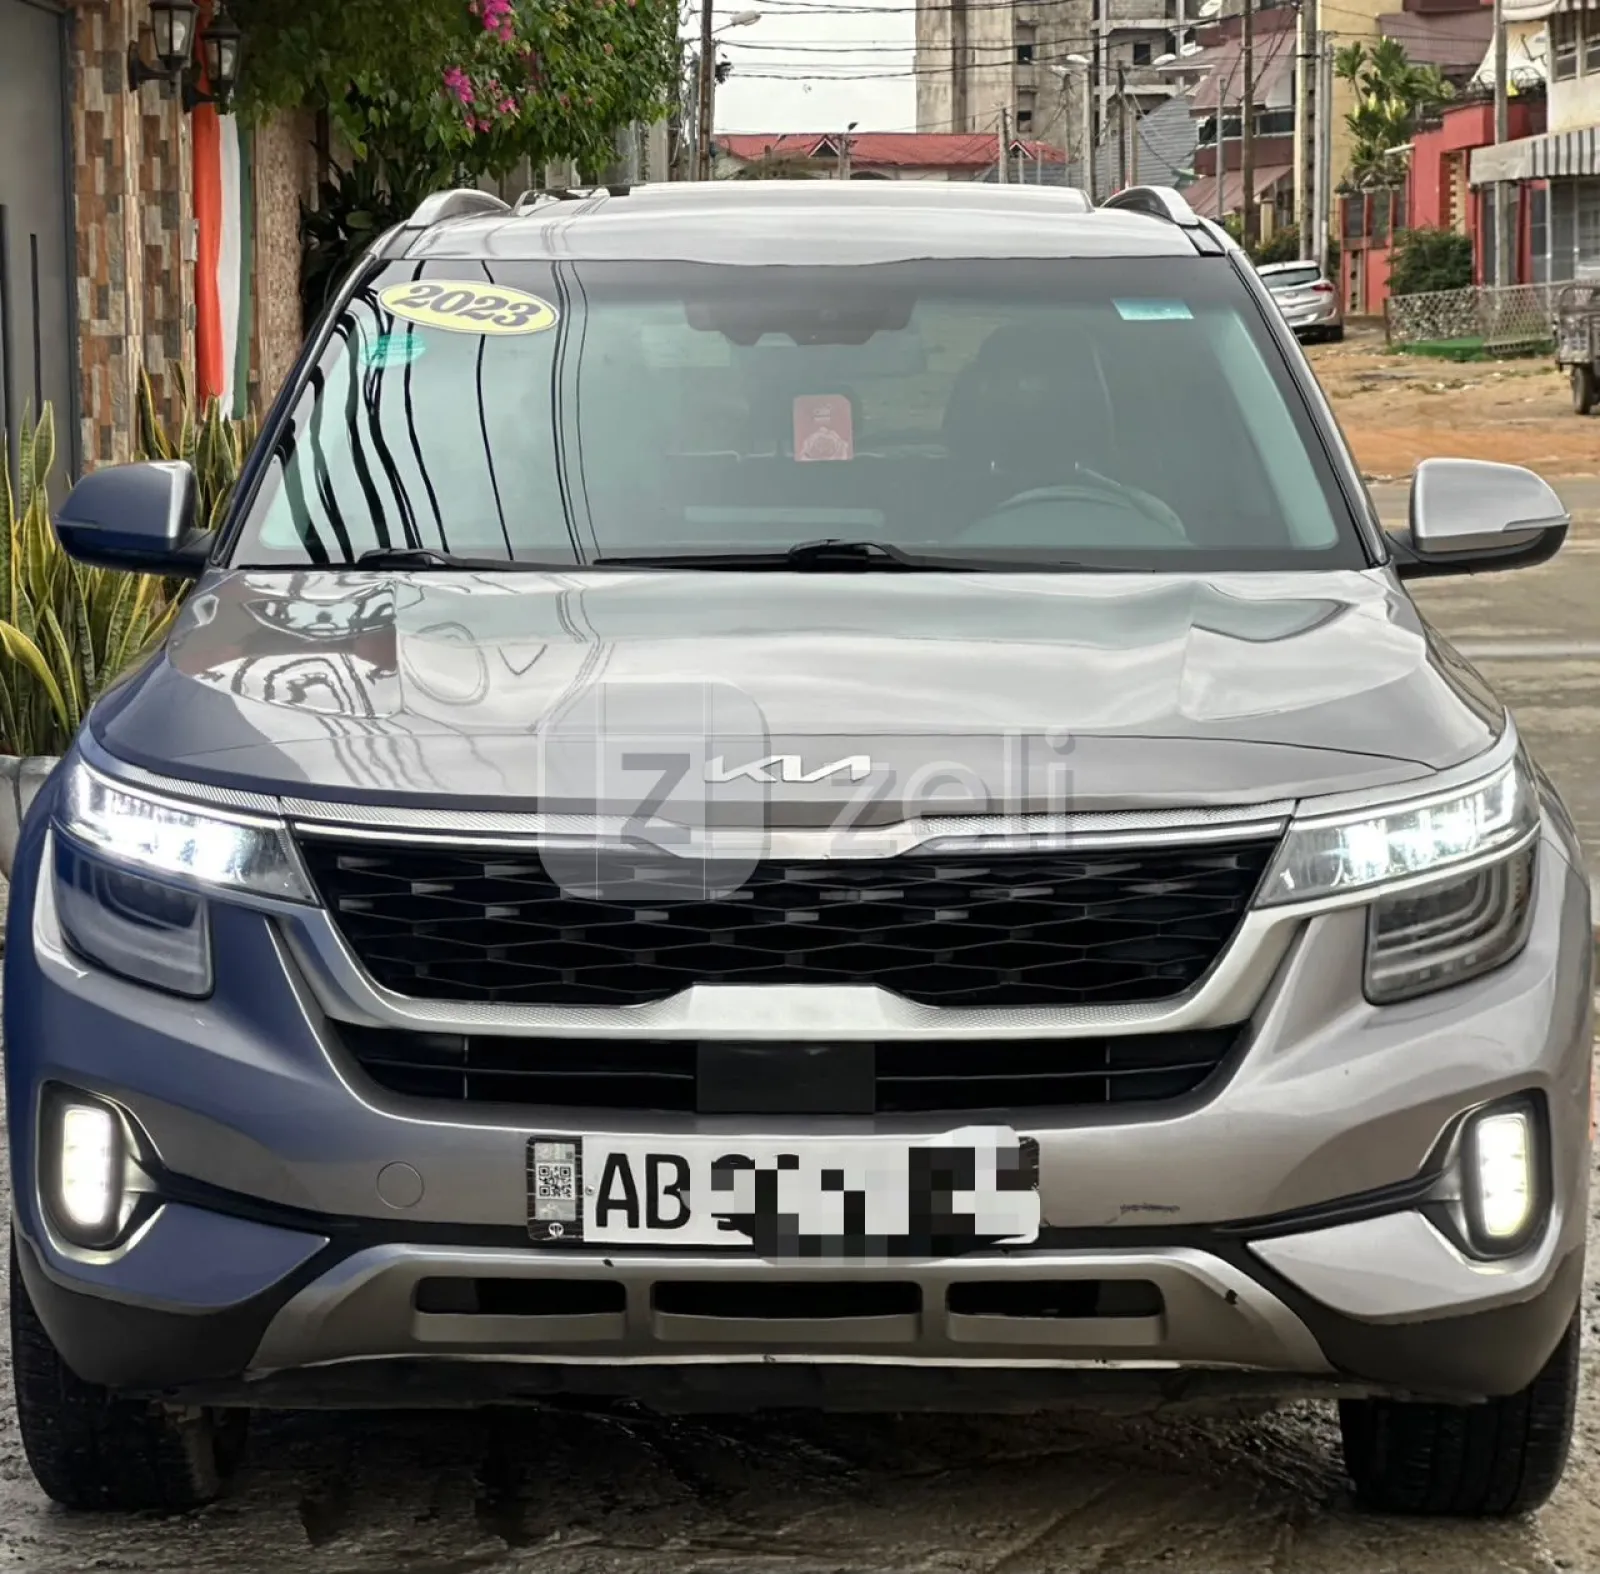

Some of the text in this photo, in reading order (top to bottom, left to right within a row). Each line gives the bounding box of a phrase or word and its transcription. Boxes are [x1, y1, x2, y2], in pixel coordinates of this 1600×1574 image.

[393, 284, 542, 327] 2023
[704, 754, 871, 783] KIA
[595, 1152, 691, 1230] AB
